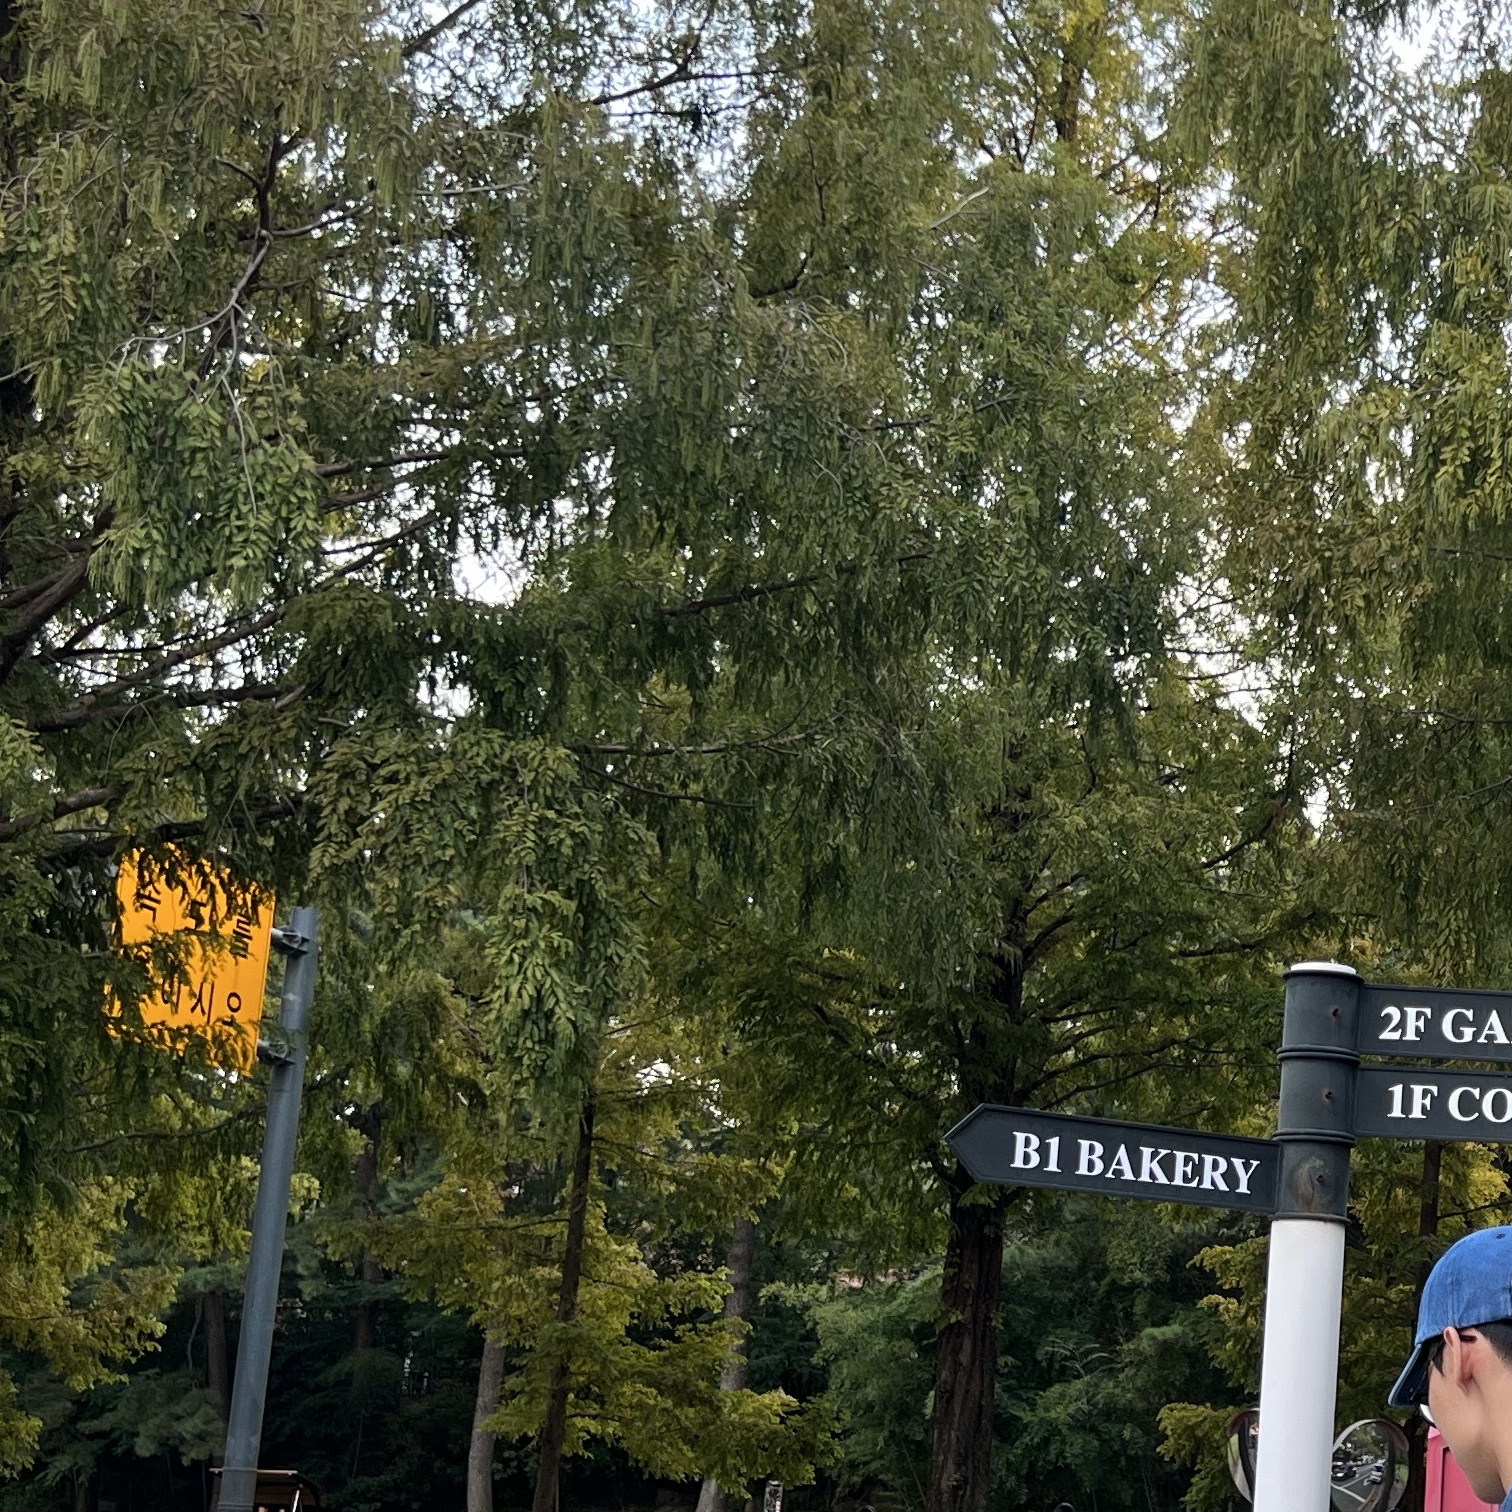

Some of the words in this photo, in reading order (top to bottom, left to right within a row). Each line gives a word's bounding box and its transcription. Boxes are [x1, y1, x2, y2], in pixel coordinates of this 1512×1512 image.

[1378, 1006, 1432, 1041] 2F
[1387, 1083, 1438, 1119] 1F
[1010, 1131, 1062, 1173] B1
[1075, 1139, 1260, 1194] BAKERY
